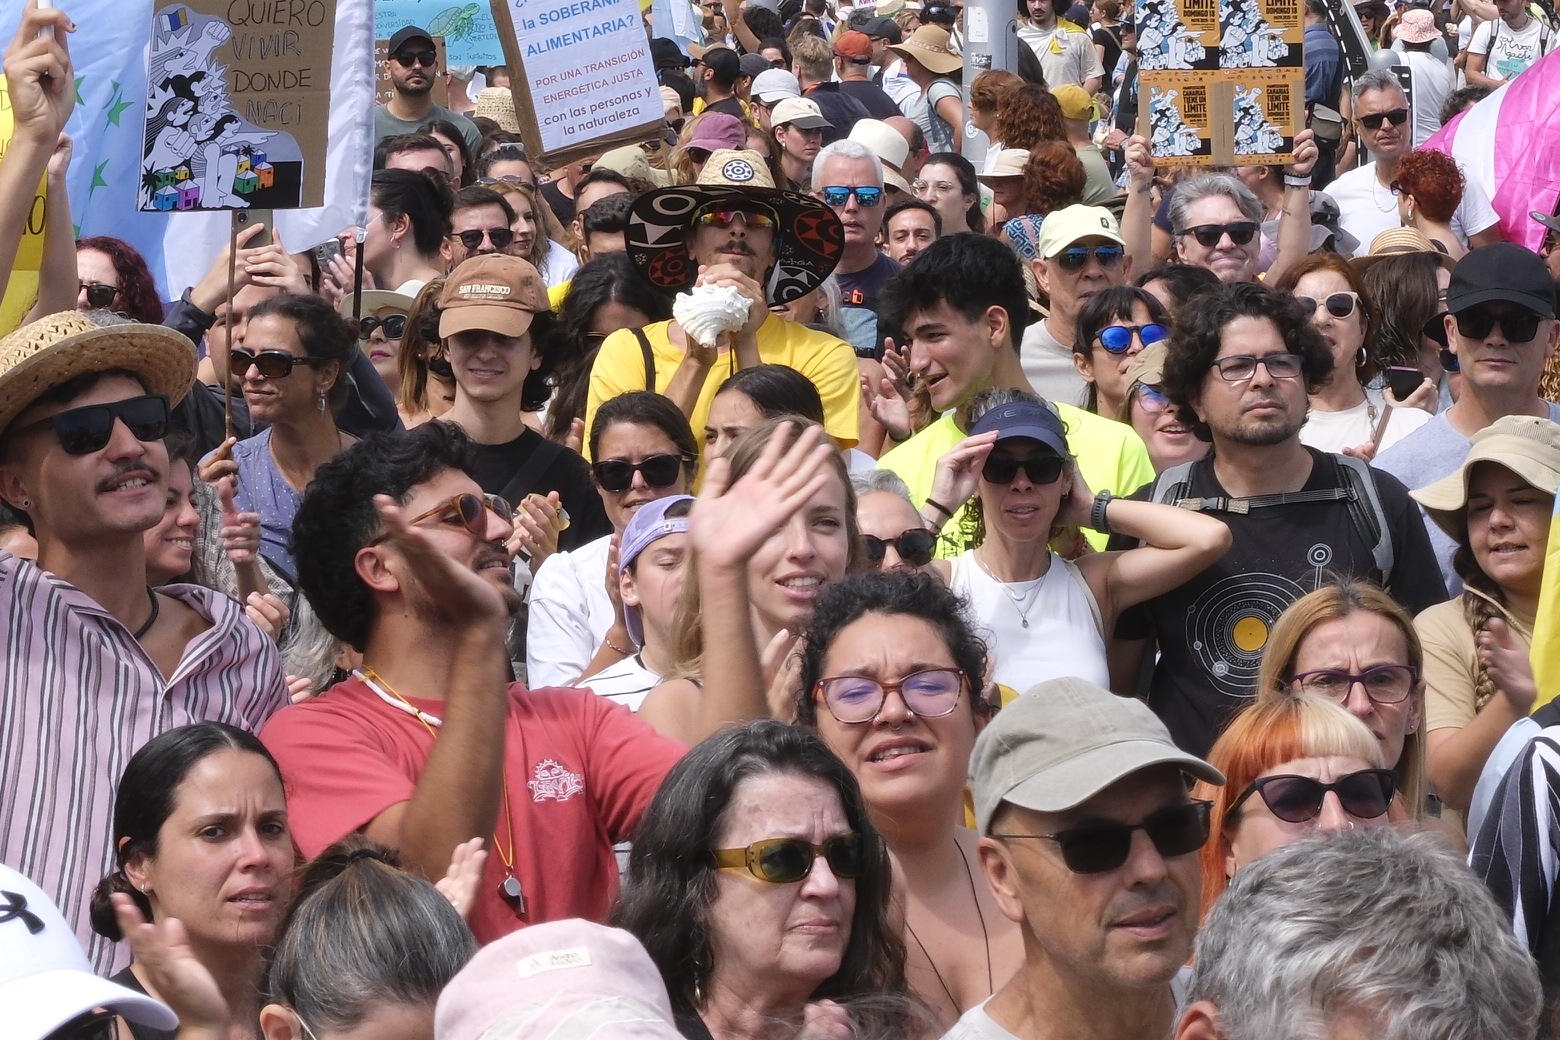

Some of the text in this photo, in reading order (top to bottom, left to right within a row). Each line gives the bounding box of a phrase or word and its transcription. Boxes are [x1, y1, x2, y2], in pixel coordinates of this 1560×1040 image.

[1183, 10, 1215, 18] DOMINGO 18
[1266, 6, 1297, 15] DOMINGO 18
[522, 18, 535, 30] la
[527, 14, 635, 57] ALIMENTARIA?
[232, 30, 302, 61] VIVIR
[535, 48, 645, 88] POR UNA TRANSICIÓN
[232, 68, 312, 92] DONDE
[543, 67, 644, 104] ENERGÉTICA JUSTA
[1267, 88, 1289, 96] CANARIAS
[1183, 96, 1198, 104] TIENE
[1282, 94, 1289, 102] UN
[544, 87, 652, 126] con las personas y
[1183, 103, 1207, 113] LÍMITE
[1267, 101, 1289, 111] LÍMITE
[563, 106, 640, 136] la naturaleza
[459, 284, 511, 295] SAN FRANCISCO
